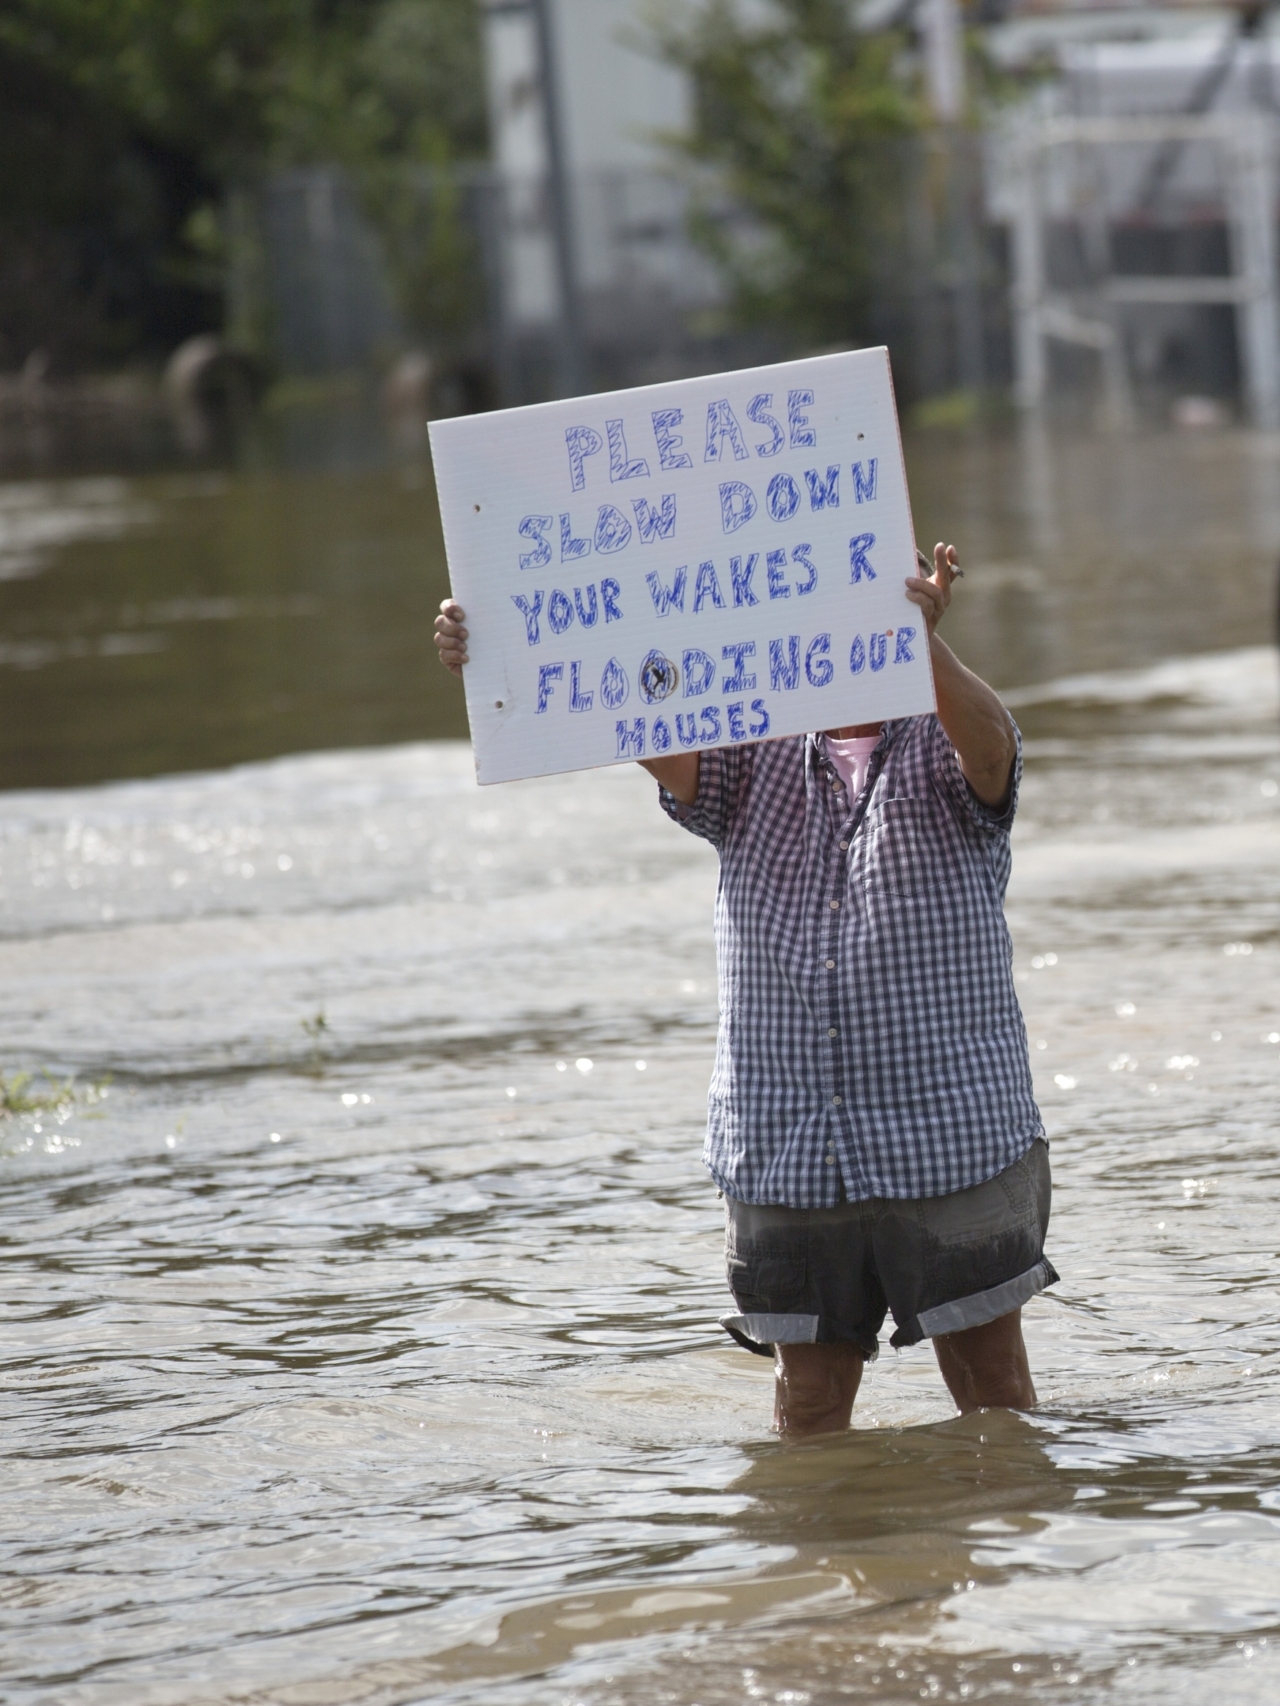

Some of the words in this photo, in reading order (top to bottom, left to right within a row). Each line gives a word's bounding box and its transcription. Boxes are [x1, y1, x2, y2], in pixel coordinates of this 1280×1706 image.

[565, 390, 816, 491] PLEASE
[519, 494, 677, 569] SLOW
[718, 458, 878, 534] DOWN
[511, 578, 623, 645] YOUR
[646, 543, 818, 617] WAKES
[849, 532, 877, 584] R
[534, 633, 832, 713] FLOODING
[850, 627, 916, 675] OUR
[615, 698, 770, 758] HOUSES
